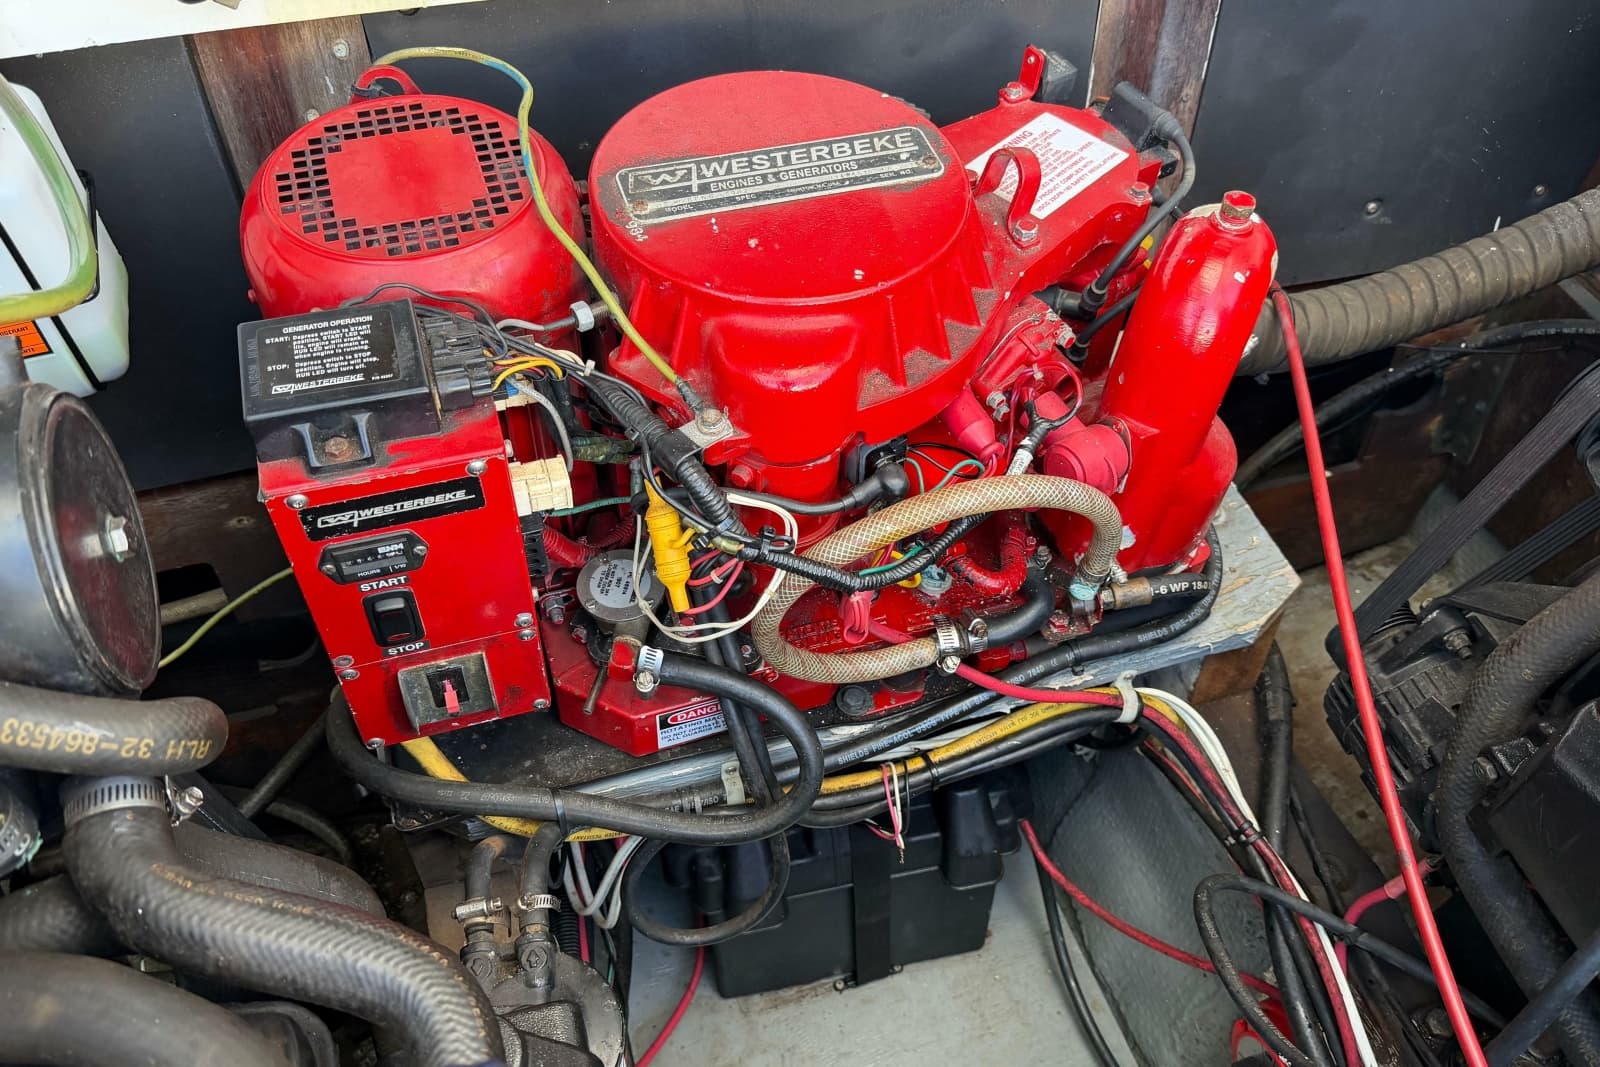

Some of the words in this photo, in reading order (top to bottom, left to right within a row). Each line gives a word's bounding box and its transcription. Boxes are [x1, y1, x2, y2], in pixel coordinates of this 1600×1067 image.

[700, 133, 914, 178] WESTERBEKE
[710, 175, 762, 191] ENGINES
[766, 173, 775, 182] &
[780, 161, 857, 179] GENERATORS
[664, 203, 693, 213] MODEL
[282, 323, 328, 334] GENERATOR
[330, 315, 372, 327] OPERATION
[265, 335, 290, 344] START:
[294, 374, 364, 390] WESTERBEKE
[360, 489, 466, 518] WESTERBEKE
[357, 568, 381, 576] HOURS
[360, 575, 407, 592] START
[1168, 581, 1189, 592] WP
[1137, 628, 1168, 642] SHIELDS
[388, 642, 424, 655] STOP
[0, 717, 154, 758] 32-864533
[837, 745, 869, 767] SHIELDS
